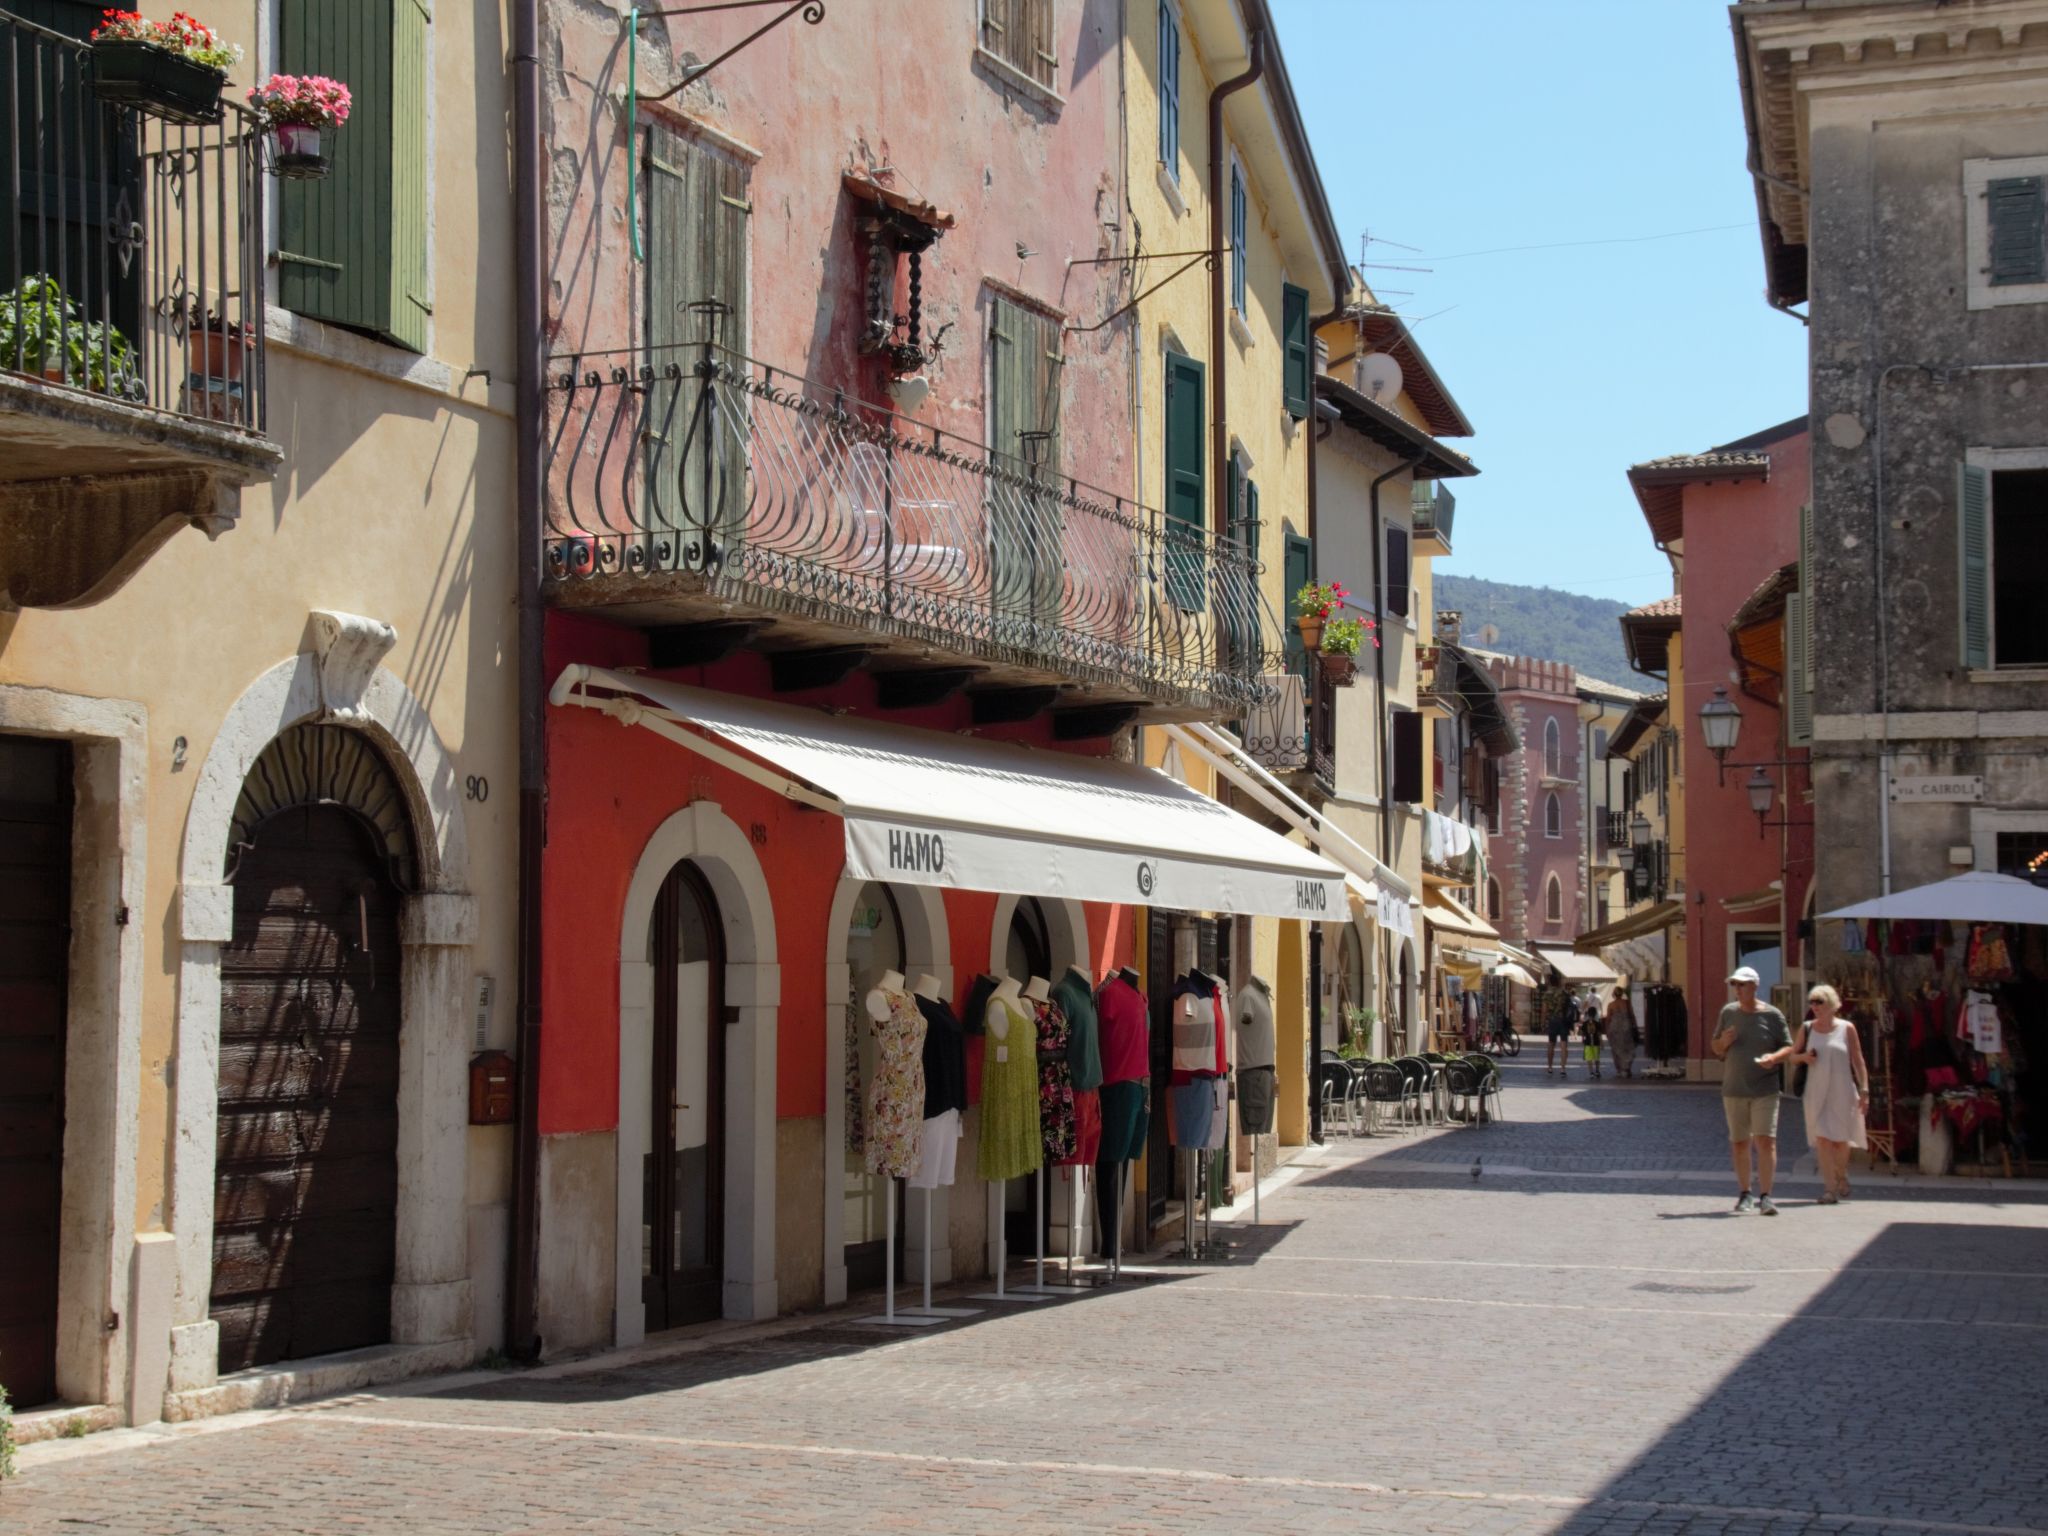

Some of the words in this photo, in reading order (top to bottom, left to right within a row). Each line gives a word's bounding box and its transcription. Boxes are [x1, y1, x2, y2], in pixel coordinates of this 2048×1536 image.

[173, 735, 188, 766] 2
[466, 774, 488, 803] 90
[1921, 783, 1974, 795] CAIROLI
[889, 830, 943, 873] HAMO
[1297, 881, 1326, 911] HAMO
